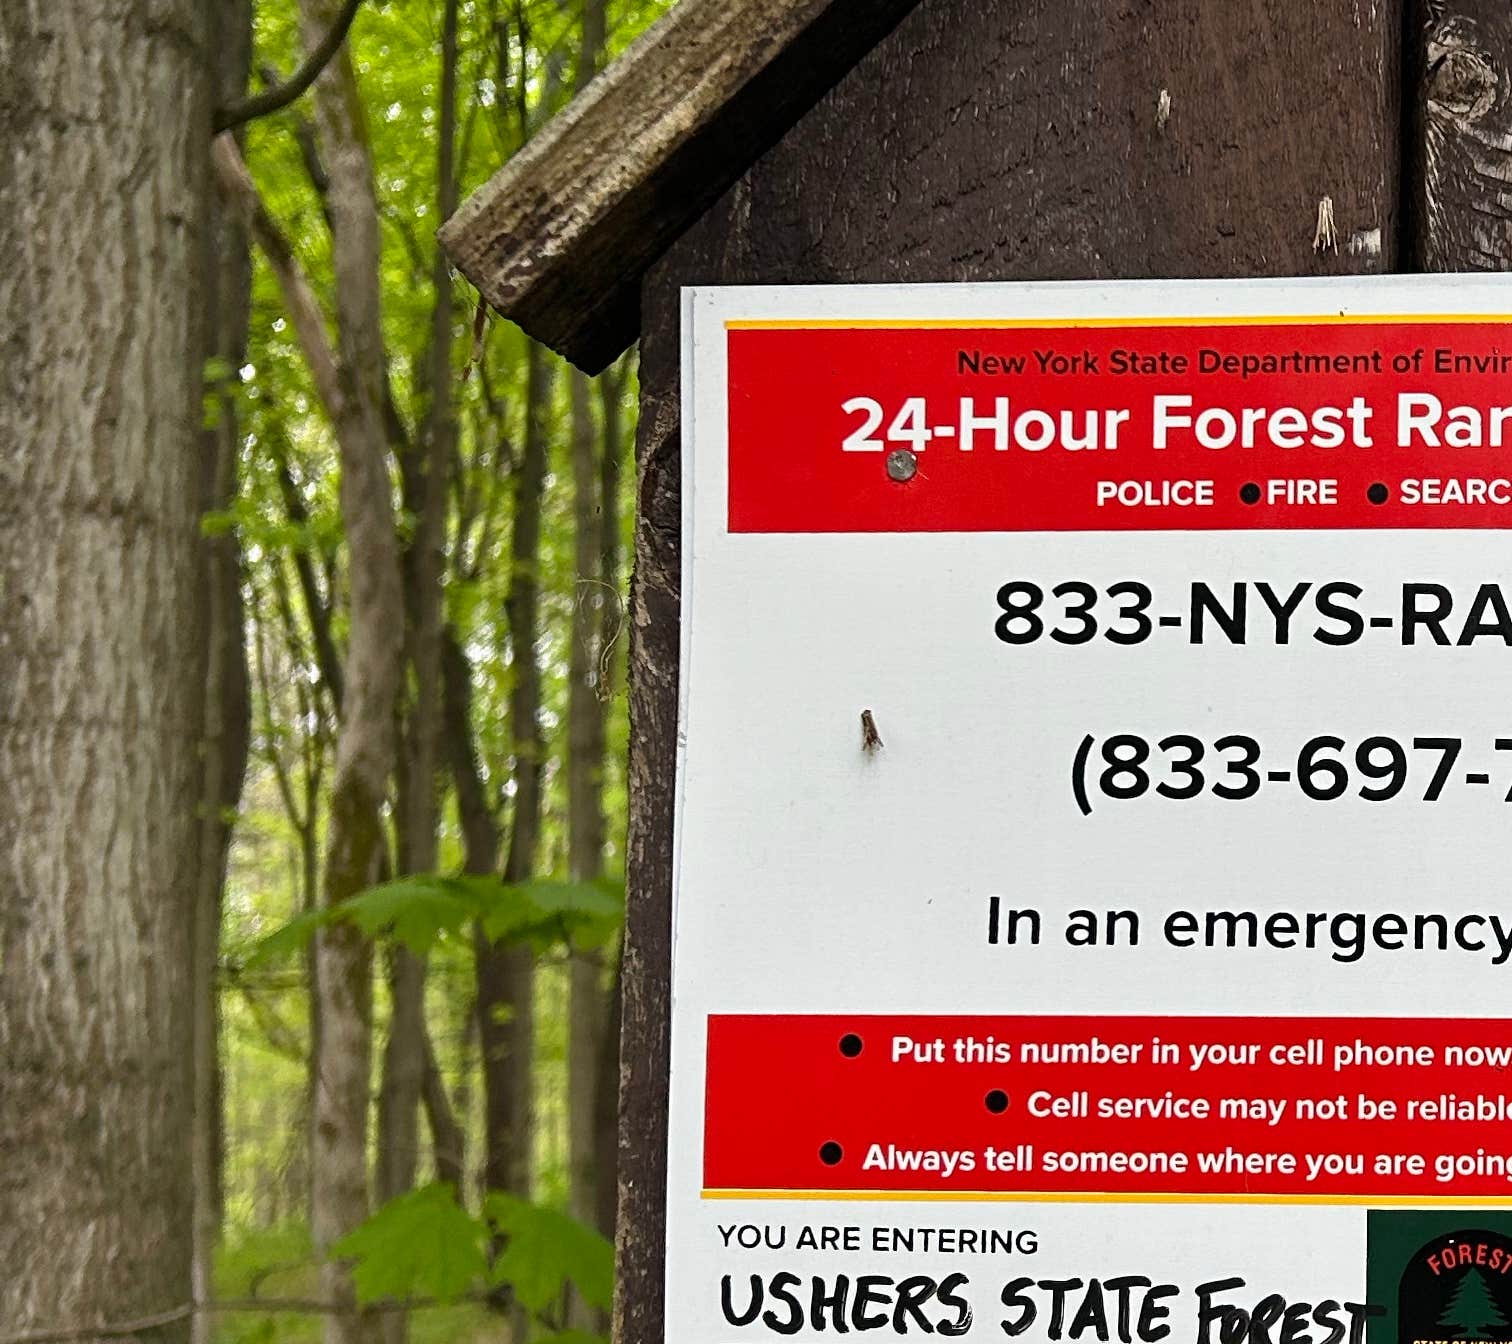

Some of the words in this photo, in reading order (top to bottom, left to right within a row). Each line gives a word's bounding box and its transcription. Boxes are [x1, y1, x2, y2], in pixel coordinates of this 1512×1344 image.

[958, 350, 1026, 375] New
[1033, 350, 1099, 375] York
[1110, 349, 1188, 375] State
[1199, 349, 1382, 380] Department
[1392, 348, 1425, 374] of
[841, 397, 1129, 452] 24-Hour
[1152, 394, 1374, 450] Forest
[1096, 479, 1214, 507] POLICE
[1267, 479, 1338, 505] FIRE
[988, 896, 1041, 945] In
[1065, 909, 1139, 946] an
[891, 1036, 946, 1063] Put
[952, 1036, 1012, 1064] this
[1020, 1037, 1144, 1064] number
[1152, 1036, 1180, 1064] in
[1188, 1044, 1261, 1072] your
[1269, 1038, 1324, 1066] cell
[1334, 1039, 1435, 1072] phone
[1027, 1090, 1088, 1118] Cell
[1097, 1091, 1210, 1119] service
[1219, 1098, 1287, 1126] may
[1296, 1095, 1348, 1120] not
[1357, 1093, 1397, 1120] be
[862, 1143, 976, 1178] Always
[983, 1144, 1033, 1172] tell
[1042, 1151, 1189, 1173] someone
[1196, 1146, 1297, 1174] where
[1304, 1153, 1364, 1181] you
[1373, 1154, 1426, 1176] are
[717, 1224, 786, 1250] YOU
[795, 1225, 861, 1251] ARE
[872, 1227, 1038, 1255] ENTERING
[719, 1271, 974, 1337] USHERS
[999, 1274, 1180, 1344] STATE
